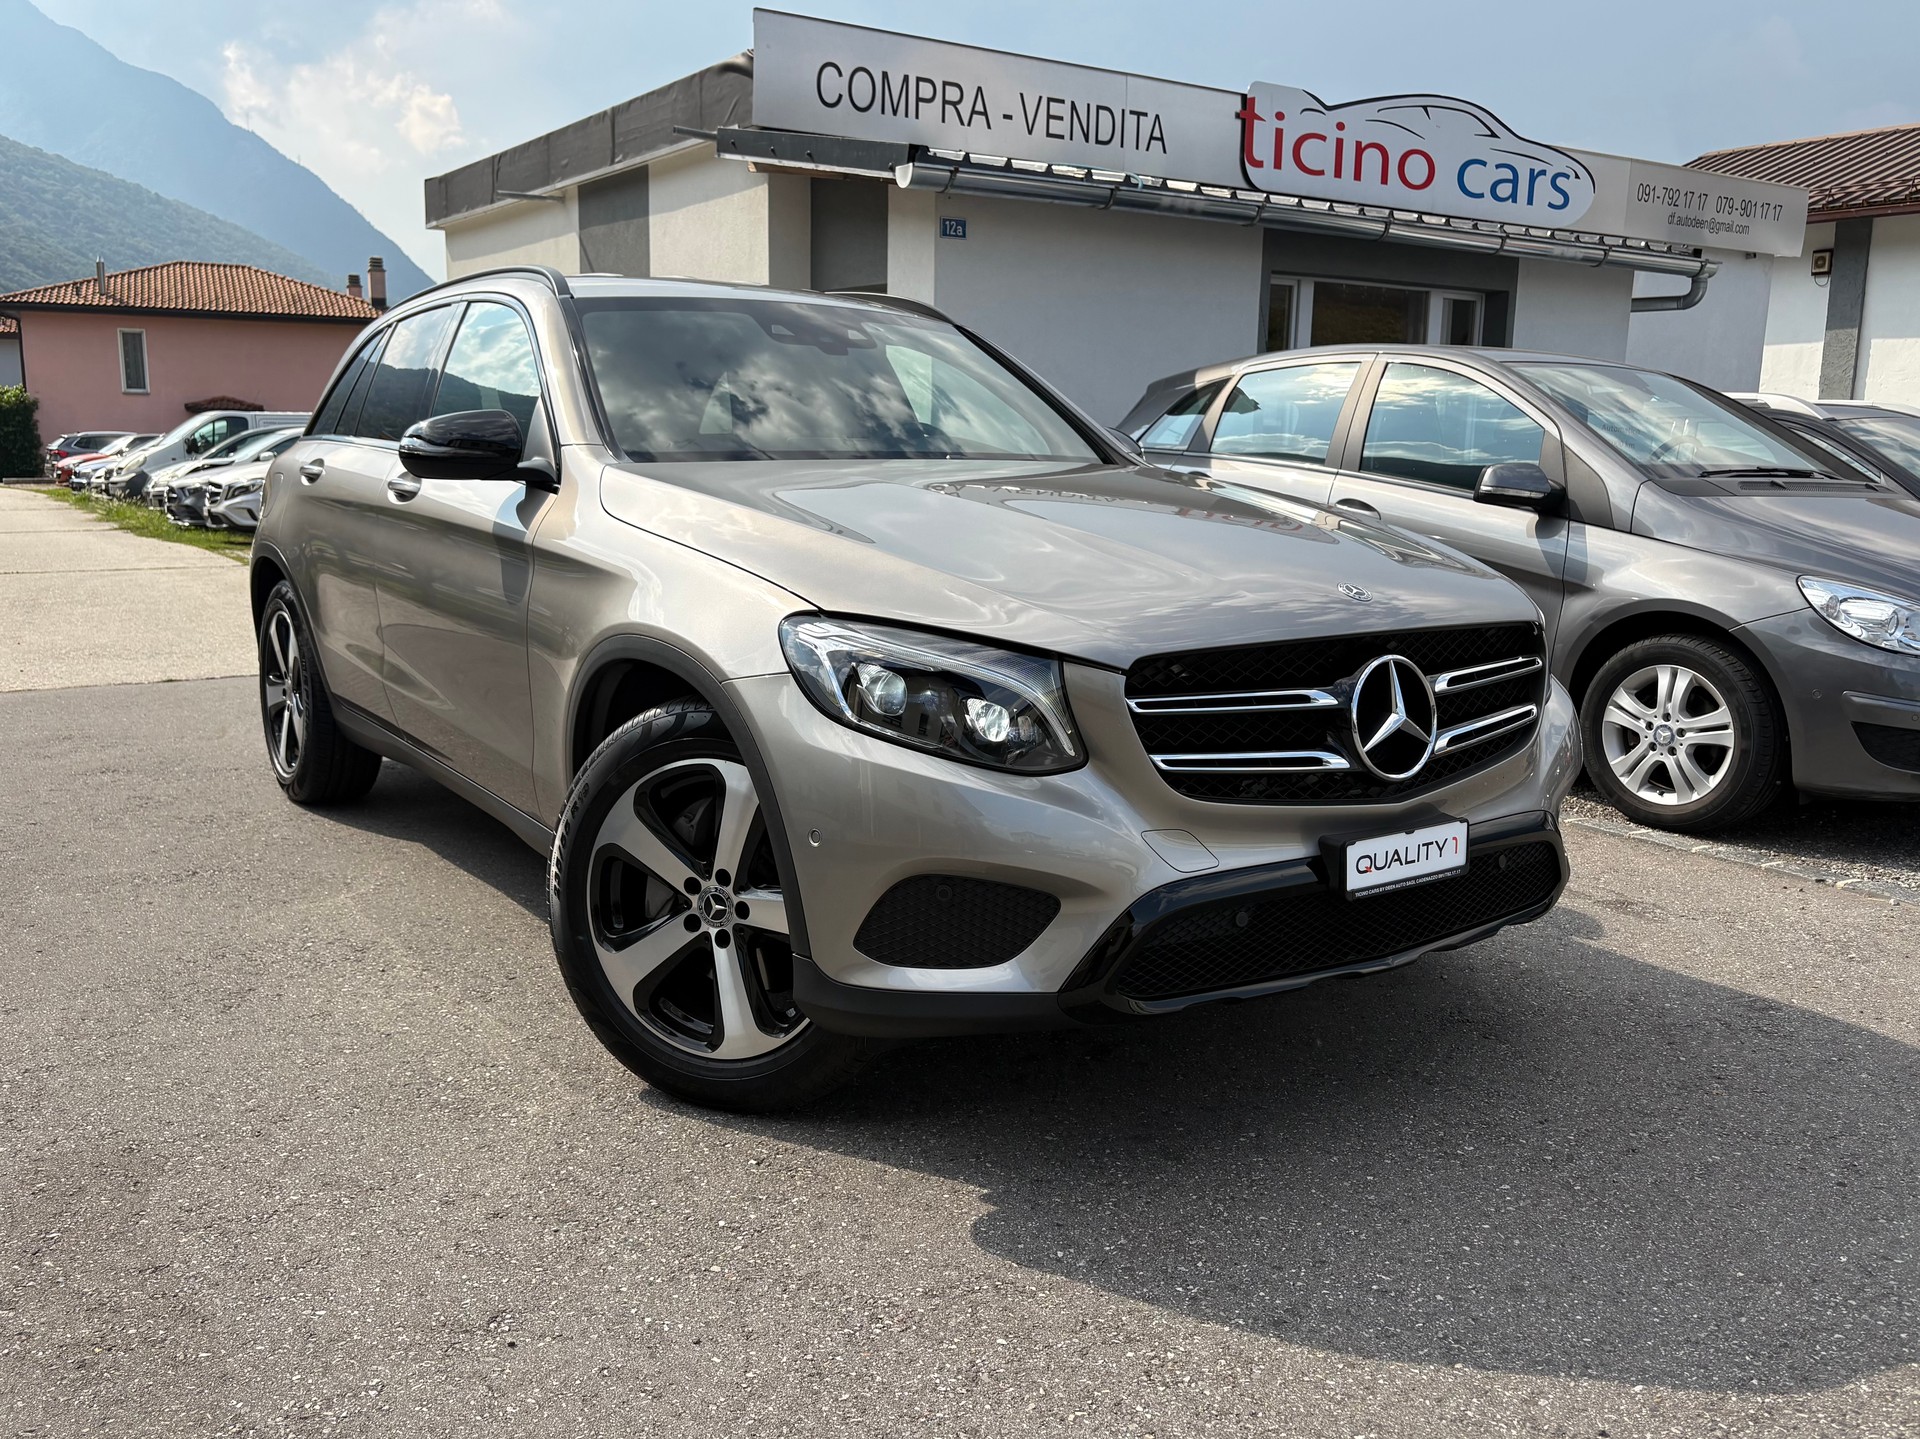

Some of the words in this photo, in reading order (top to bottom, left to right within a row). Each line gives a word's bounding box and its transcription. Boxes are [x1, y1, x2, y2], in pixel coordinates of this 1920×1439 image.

[816, 61, 992, 131] COMPRA
[1019, 92, 1168, 155] VENDITA
[1236, 96, 1436, 191] ticino
[1457, 158, 1571, 210] cars
[1636, 183, 1681, 208] 091-792
[1683, 190, 1695, 209] 17
[1697, 193, 1709, 212] 17
[1715, 195, 1758, 219] 079-901
[1760, 202, 1771, 221] 17
[1772, 204, 1784, 222] 17
[945, 221, 963, 236] 12a
[1667, 212, 1750, 236] df.autodeen@gmail.com
[1355, 837, 1449, 875] QUALITY
[1451, 836, 1459, 855] 1
